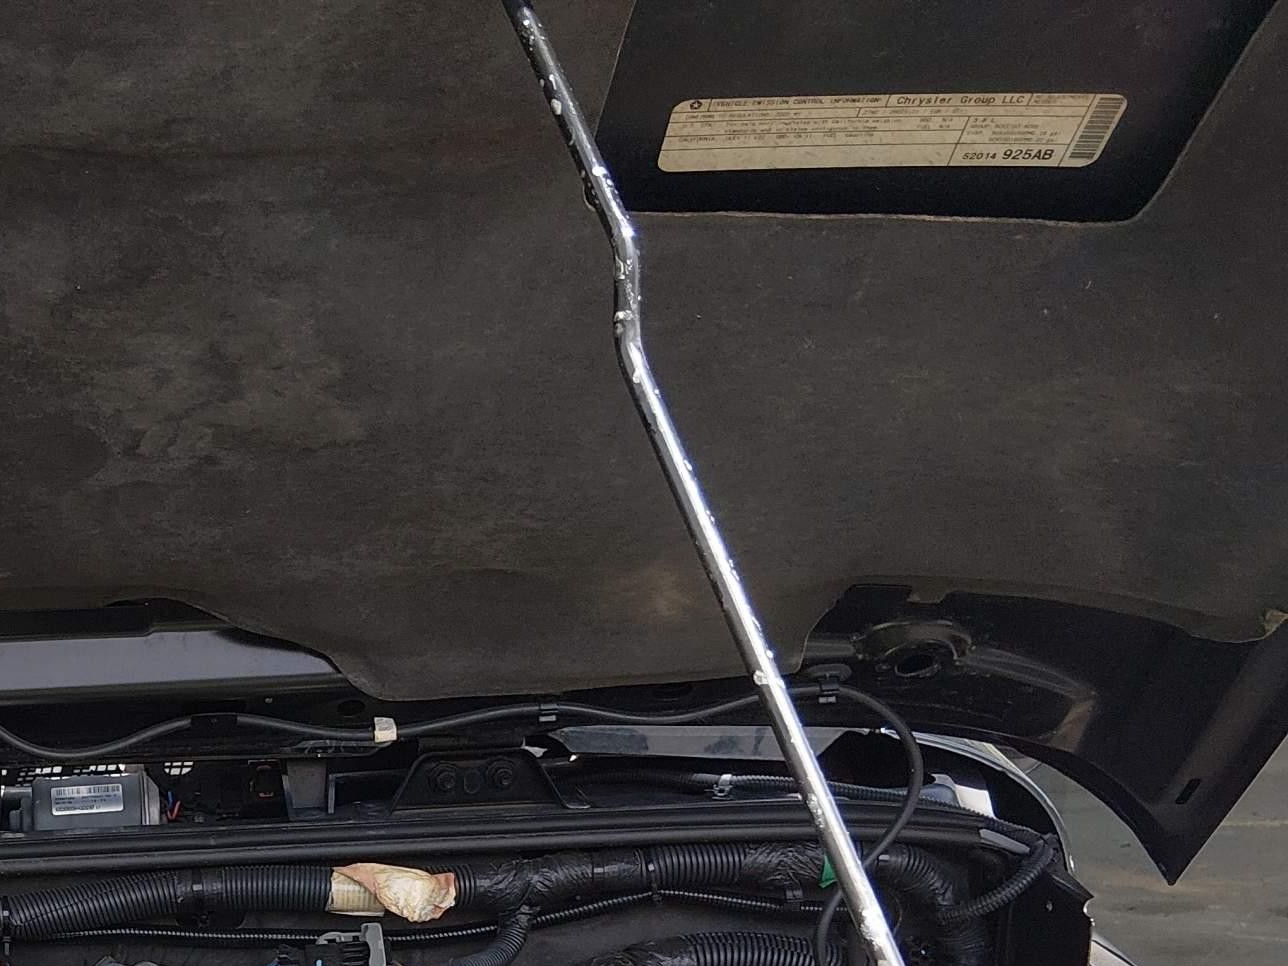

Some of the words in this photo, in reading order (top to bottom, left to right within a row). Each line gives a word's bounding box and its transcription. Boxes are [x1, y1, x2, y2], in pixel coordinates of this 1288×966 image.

[792, 97, 824, 105] CONTROL
[830, 96, 881, 104] INFORMATION
[896, 95, 953, 107] Chrysler
[960, 95, 996, 106] Group
[1002, 95, 1026, 104] LLC
[961, 151, 998, 160] 52014
[1001, 148, 1055, 160] 925AB
